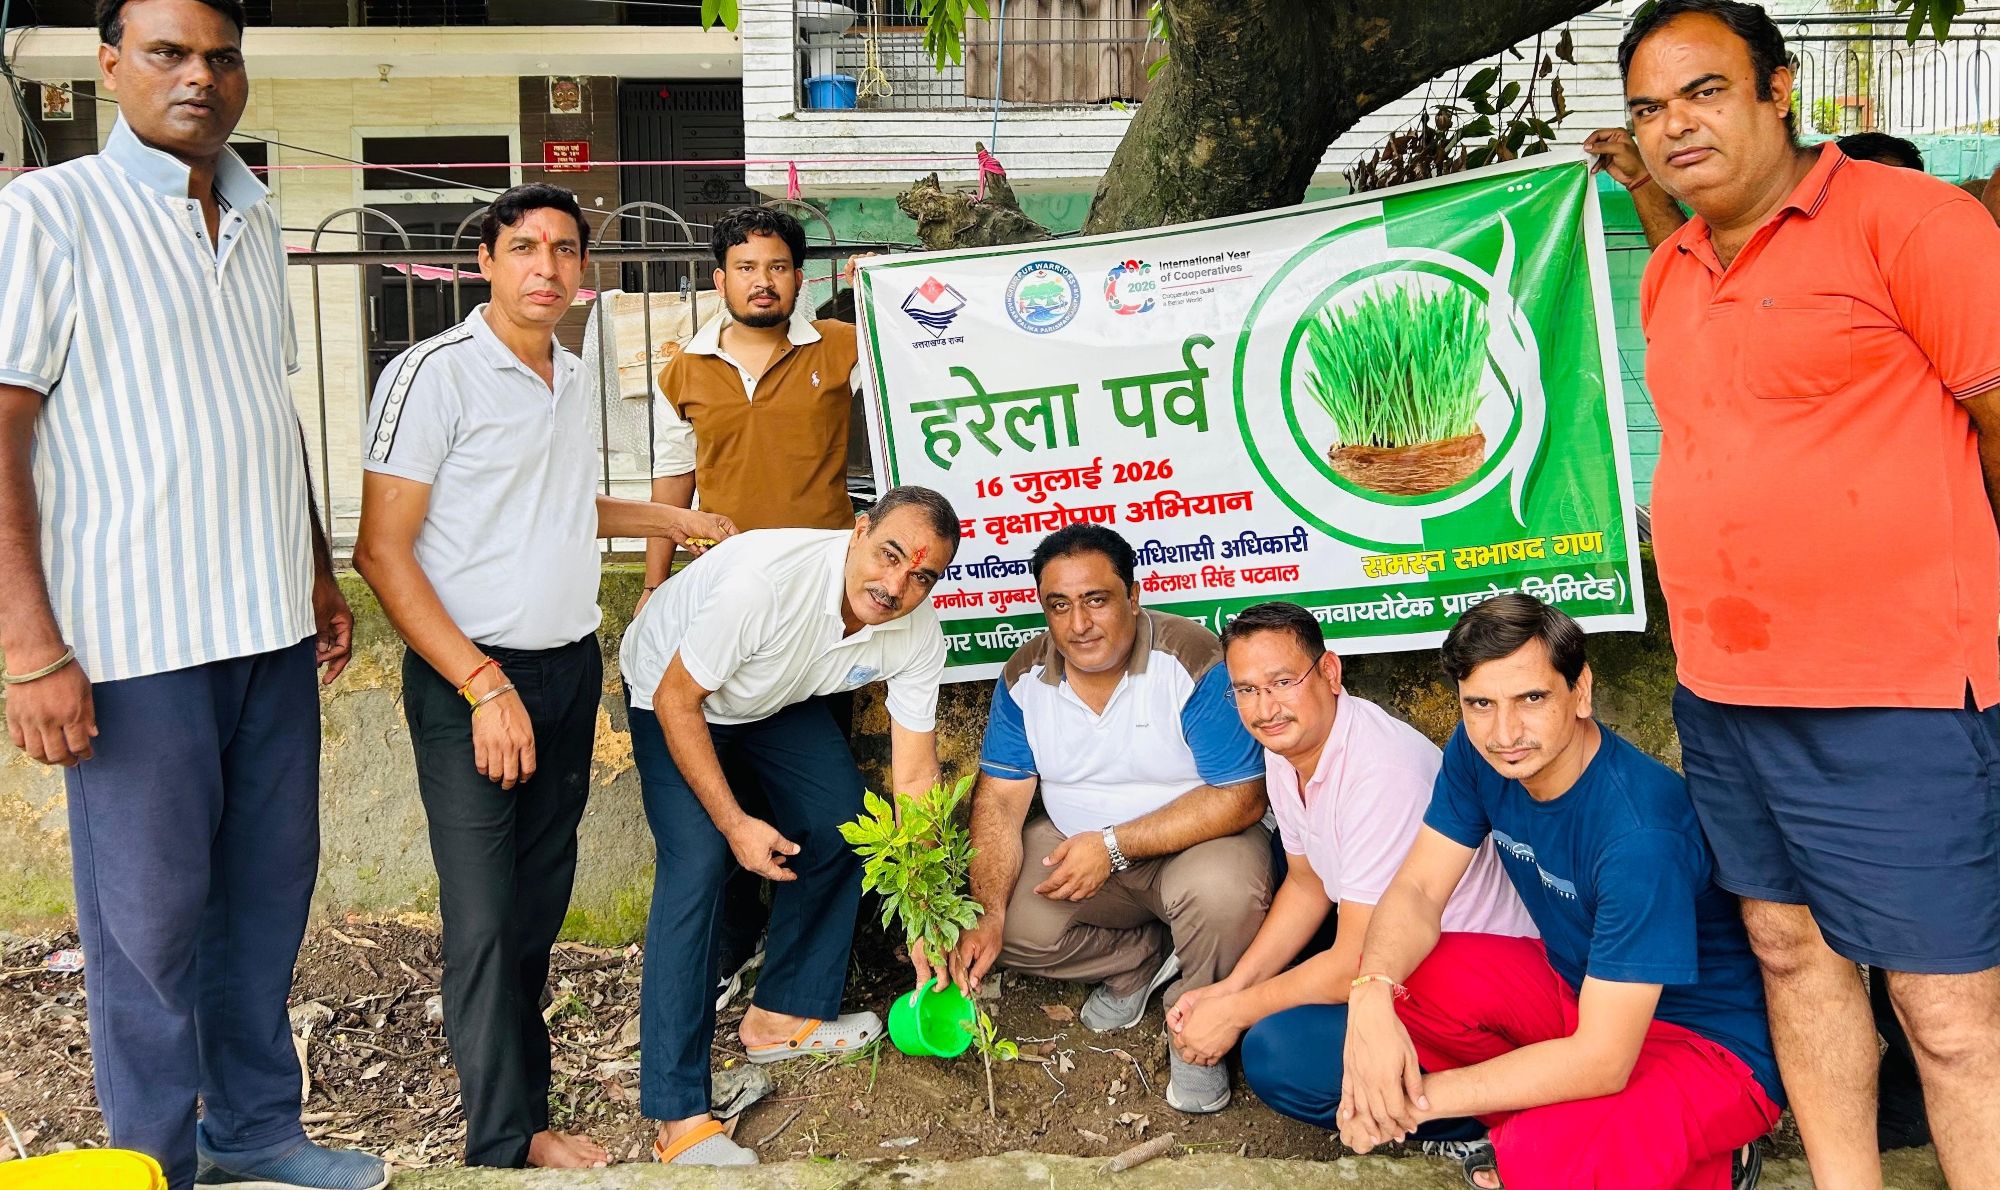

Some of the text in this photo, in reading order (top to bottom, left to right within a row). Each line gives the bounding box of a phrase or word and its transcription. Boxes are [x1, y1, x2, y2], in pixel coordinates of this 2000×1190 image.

[1159, 250, 1251, 271] International Year
[1160, 264, 1243, 283] of Cooperatives
[1035, 263, 1076, 286] WARRIORS
[1127, 280, 1156, 293] 2026
[1017, 318, 1039, 332] PALIKA
[911, 336, 965, 349] उत्तराखण्ड राज्य
[910, 333, 1216, 471] हरेला पर्व
[975, 456, 1174, 503] 16 जुलाई 2026
[983, 502, 1117, 545] वृक्षारोपण
[1125, 490, 1254, 523] अभियान
[1221, 526, 1309, 559] अधिकारी
[1361, 531, 1604, 578] समस्त सभाषद गण
[938, 555, 1034, 581] गर पालिका
[1142, 564, 1300, 592] कैलाश सिंह पटवाल
[932, 588, 1037, 614] मनोज गुम्बर
[943, 632, 972, 652] गर
[974, 623, 1049, 649] पालिक
[1305, 592, 1435, 625] नवायरोटेक
